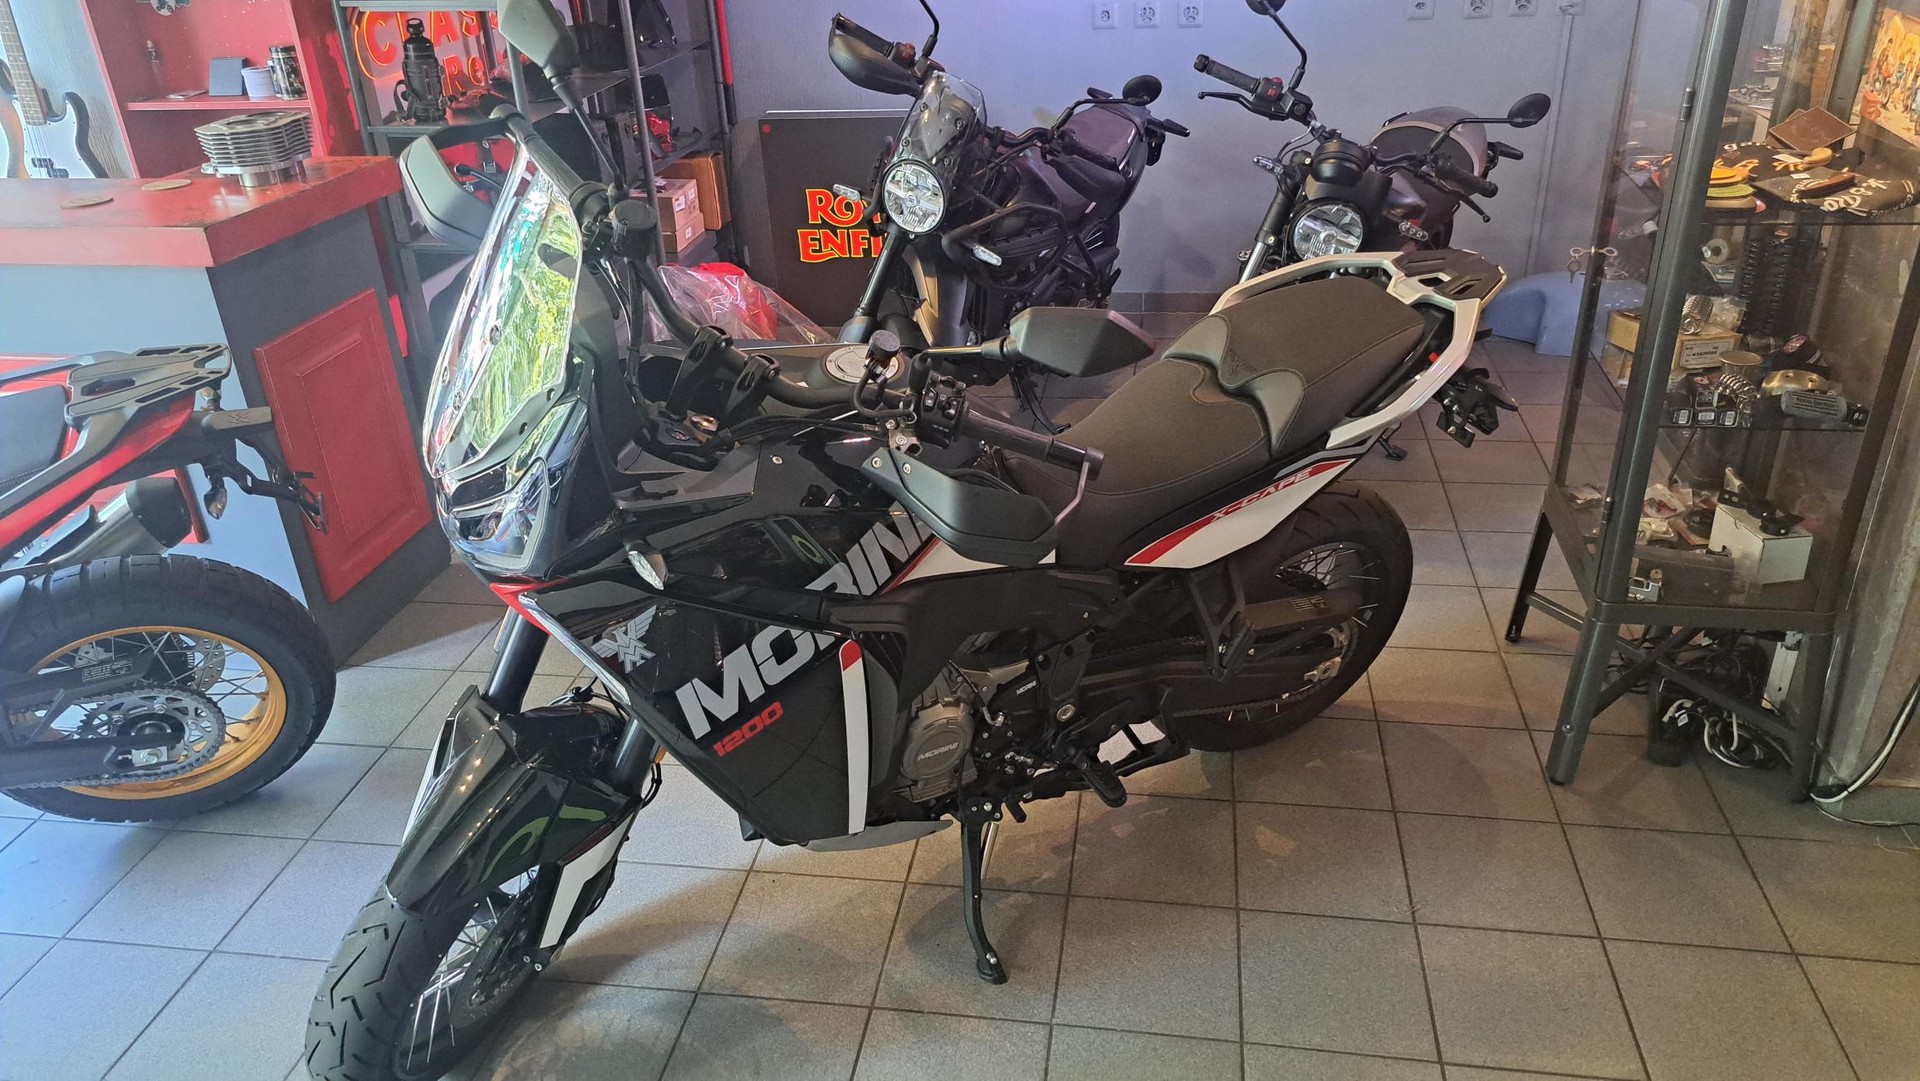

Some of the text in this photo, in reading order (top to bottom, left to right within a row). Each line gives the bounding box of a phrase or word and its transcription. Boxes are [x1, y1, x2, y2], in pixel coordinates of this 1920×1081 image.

[797, 229, 887, 263] ENFI
[1210, 467, 1313, 522] X-CAPE
[713, 701, 784, 758] 1200
[917, 741, 960, 761] MORINI
